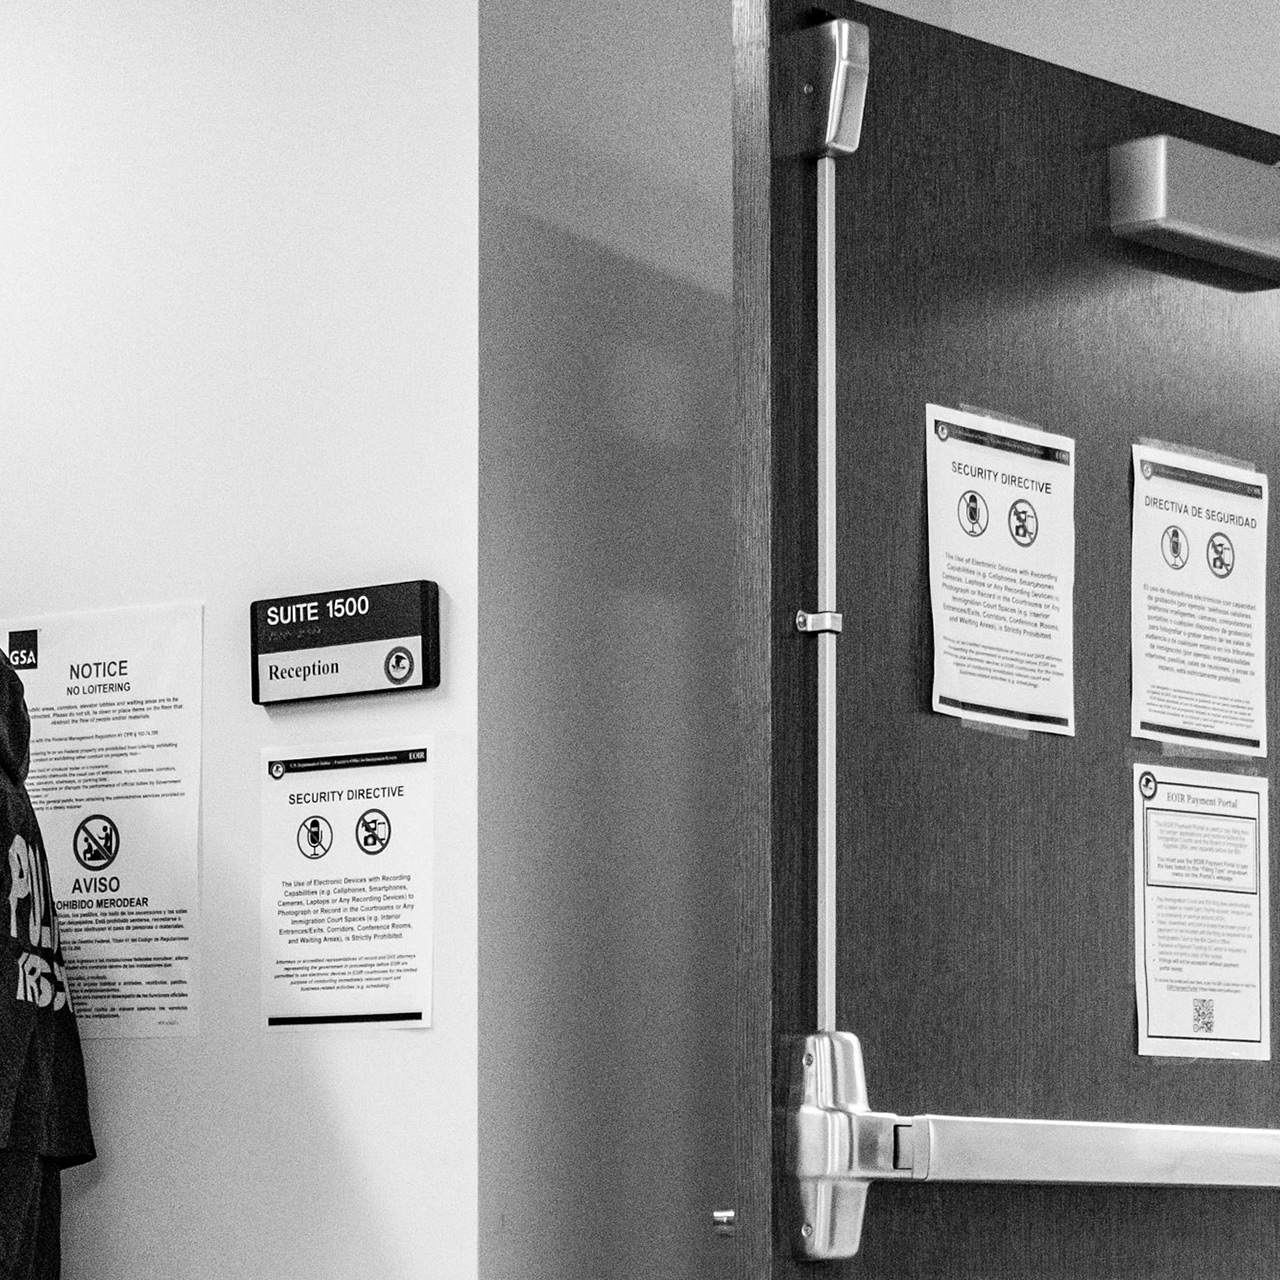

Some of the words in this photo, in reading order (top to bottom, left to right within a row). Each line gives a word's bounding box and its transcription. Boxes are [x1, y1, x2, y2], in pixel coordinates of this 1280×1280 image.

[952, 461, 998, 481] SECURITY
[1002, 473, 1052, 494] DIRECTIVE
[1145, 496, 1188, 514] DIRECTIVA
[1192, 506, 1202, 518] DE
[1206, 509, 1257, 528] SEGURIDAD
[267, 602, 318, 625] SUITE
[326, 596, 369, 618] 1500
[10, 650, 36, 665] GSA
[70, 660, 128, 680] NOTICE
[268, 660, 339, 681] Reception
[67, 685, 79, 696] NO
[83, 682, 130, 695] LOITERING
[409, 752, 425, 760] EOIR
[289, 791, 343, 805] SECURITY
[347, 786, 404, 800] DIRECTIVE
[1167, 792, 1185, 803] EOIR
[1187, 795, 1216, 806] Payment
[1218, 798, 1237, 808] Portal
[382, 873, 411, 881] Recording
[72, 876, 120, 894] AVISO
[284, 889, 317, 898] Capabilities
[306, 898, 329, 906] Laptops
[339, 896, 350, 904] Any
[352, 895, 381, 903] Recording
[56, 900, 93, 910] OHIBIDO
[97, 897, 148, 908] MERODEAR
[278, 908, 311, 917] Photograph
[321, 906, 341, 914] Record
[291, 917, 325, 926] Immigration
[345, 916, 365, 924] Spaces
[300, 936, 321, 944] Waiting
[352, 933, 372, 941] Strictly
